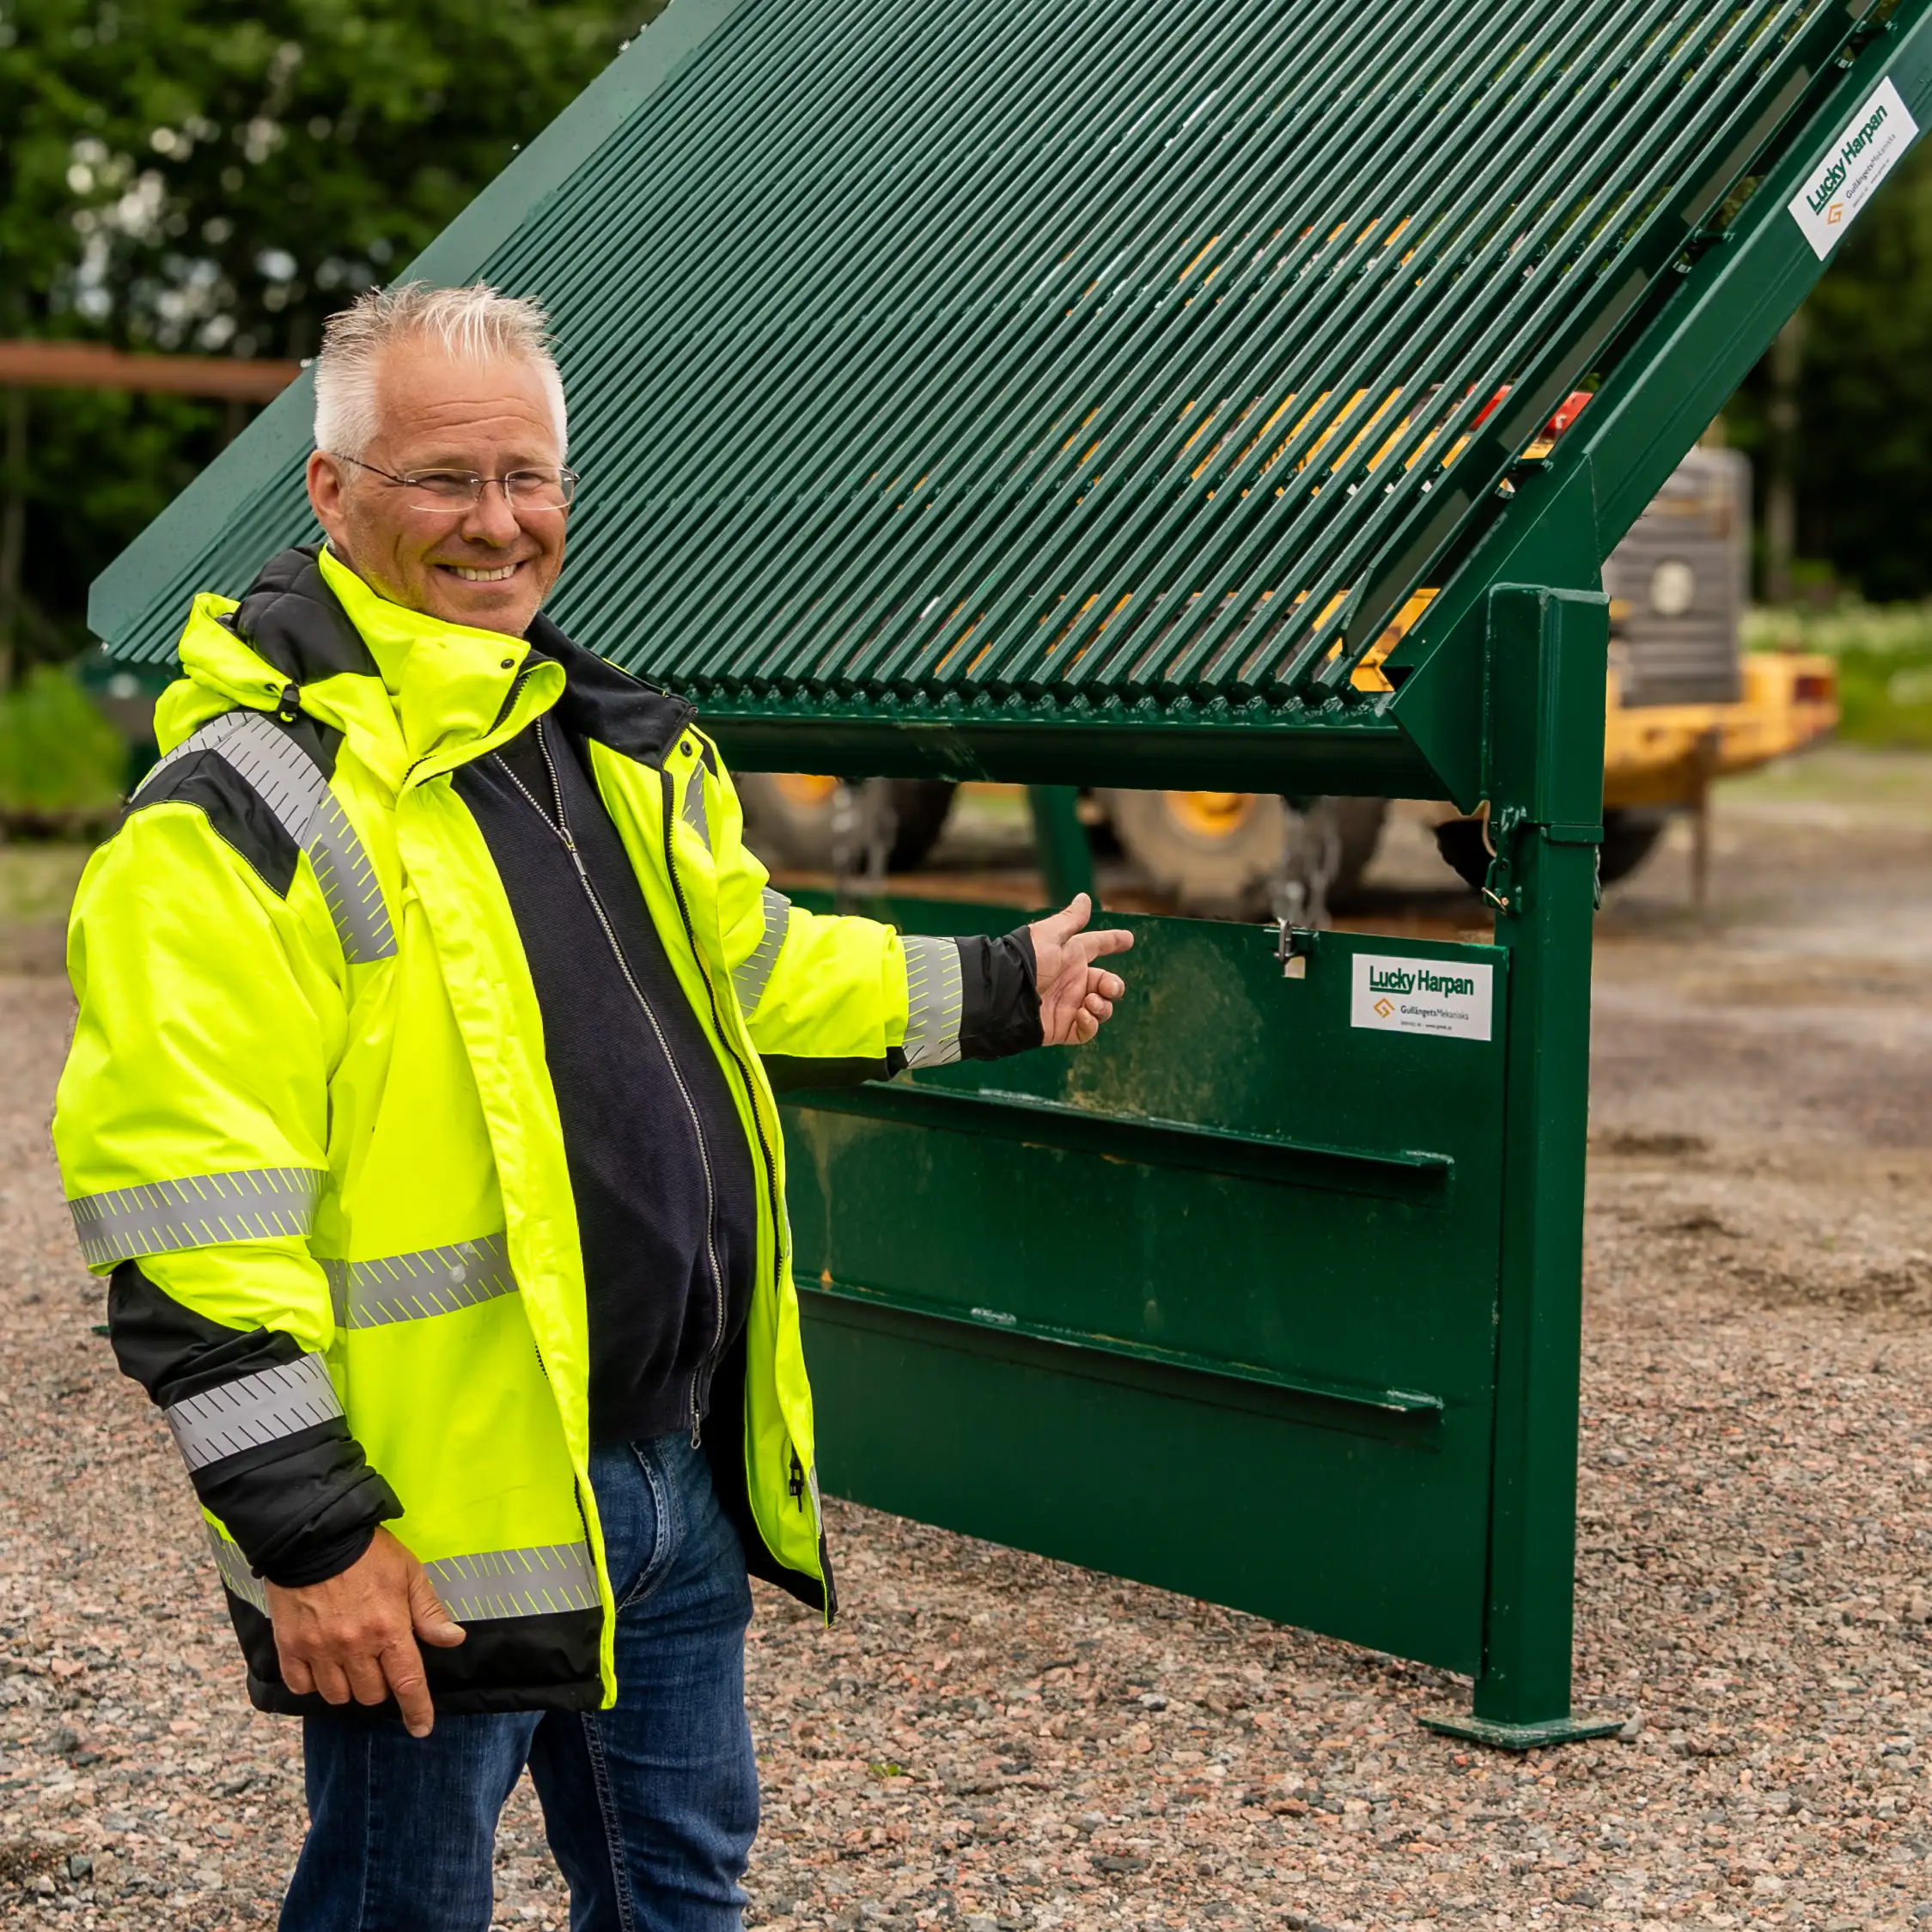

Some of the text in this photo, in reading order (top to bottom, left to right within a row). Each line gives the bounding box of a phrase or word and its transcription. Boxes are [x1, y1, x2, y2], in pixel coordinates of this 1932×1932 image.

[1806, 159, 1847, 216] Lucky
[1841, 105, 1888, 165] Harpan
[1369, 966, 1474, 998] Lucky Harpan
